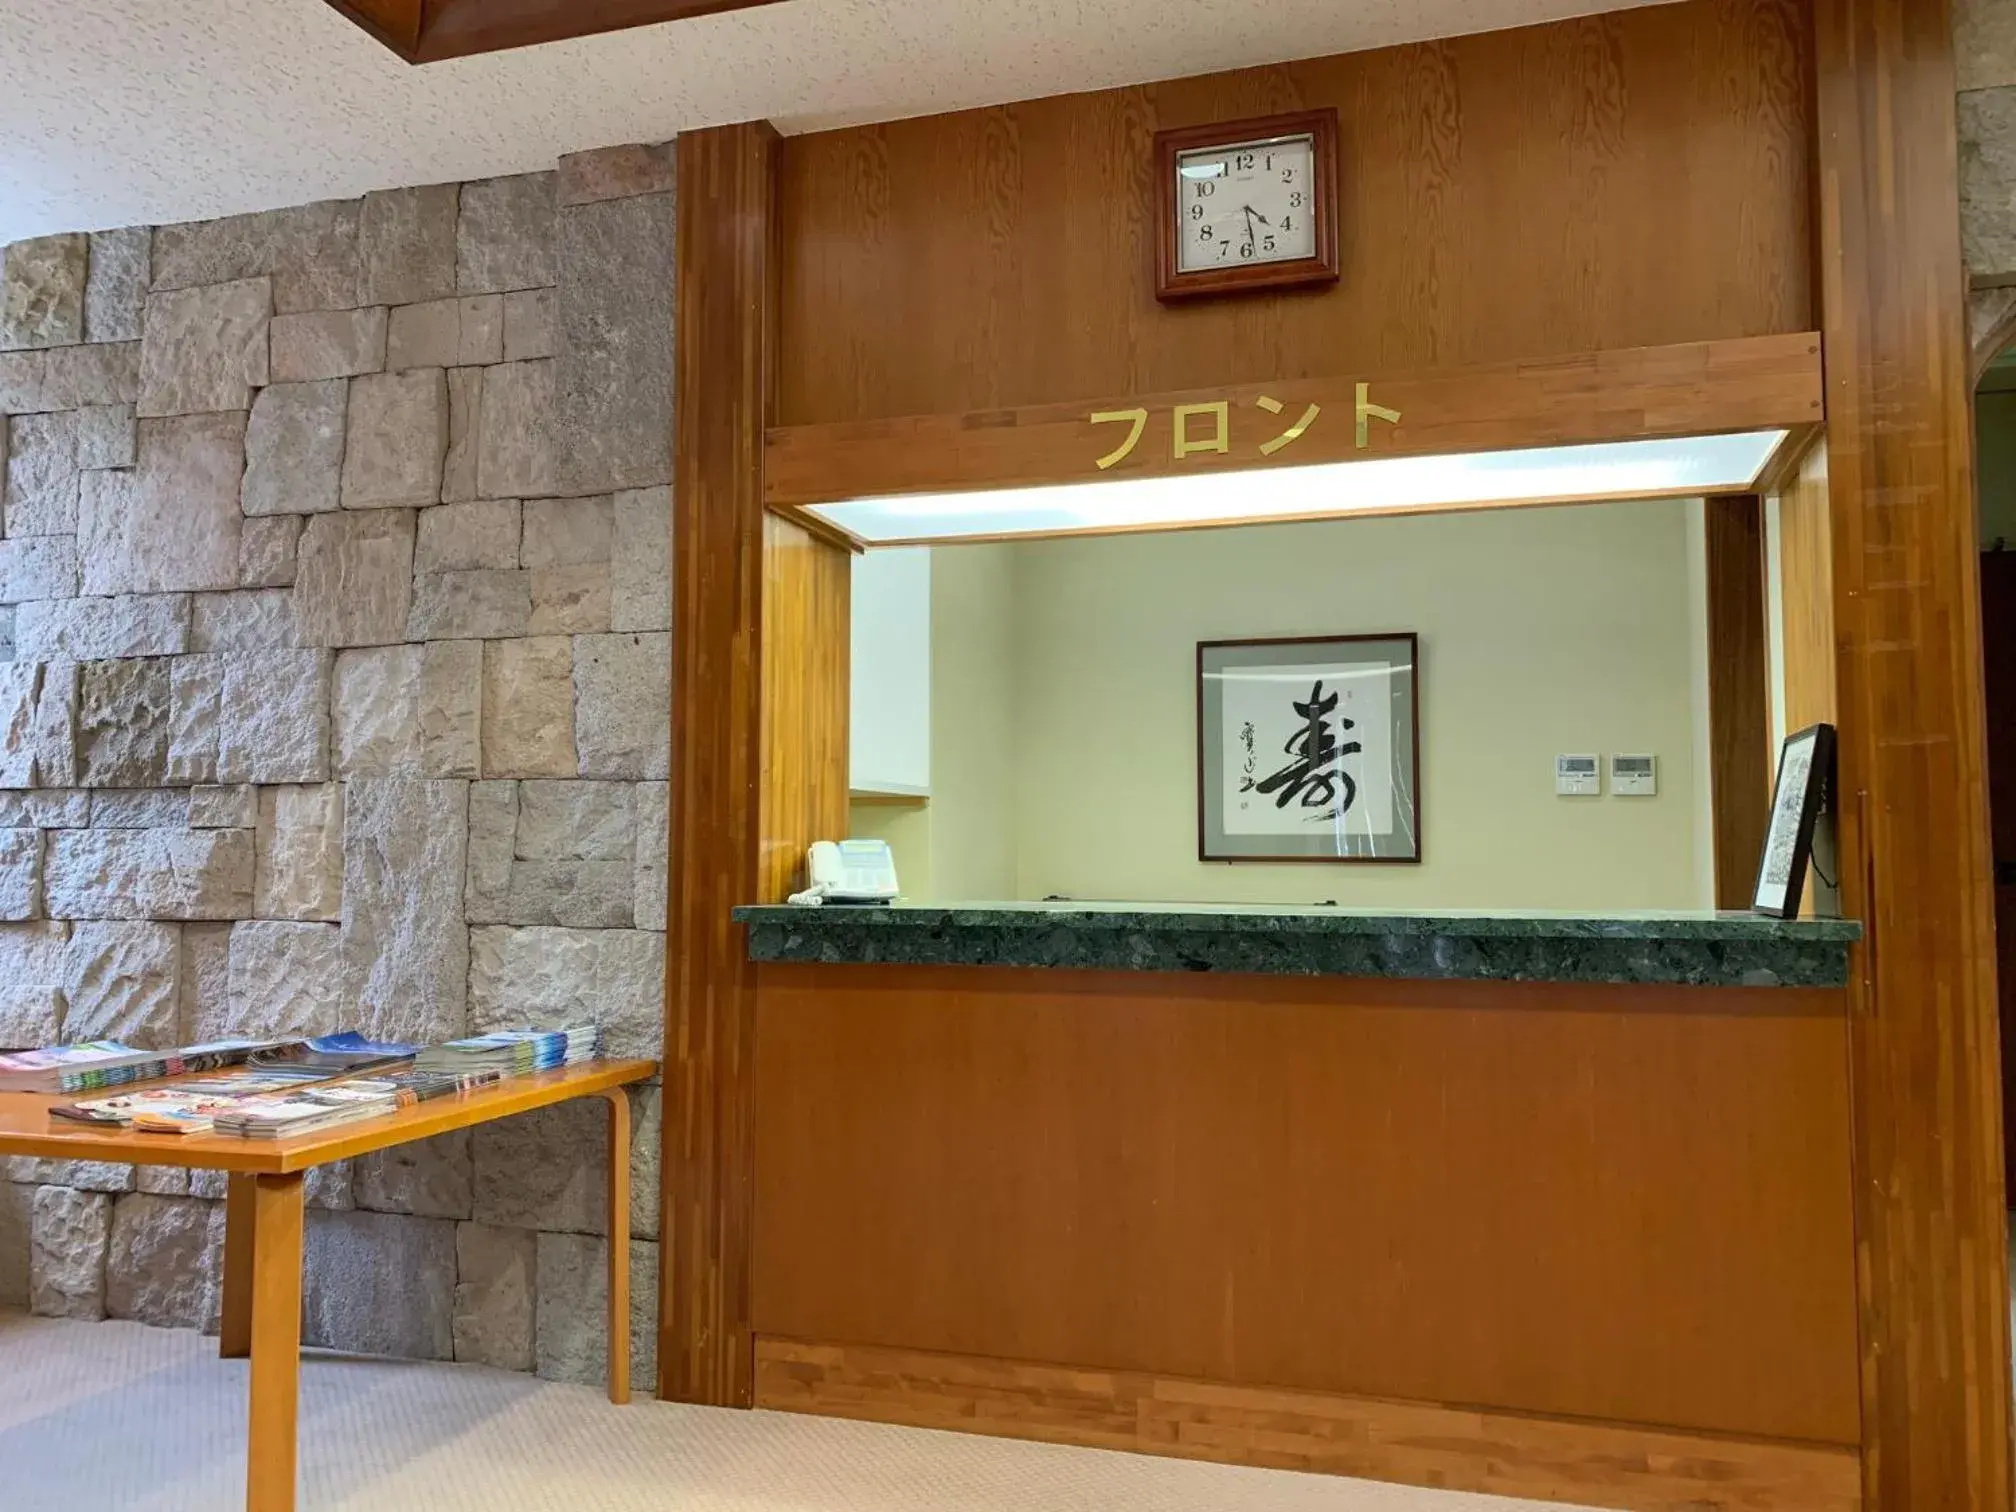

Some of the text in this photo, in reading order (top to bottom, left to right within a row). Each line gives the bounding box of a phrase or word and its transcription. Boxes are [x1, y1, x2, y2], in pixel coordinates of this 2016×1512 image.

[1236, 154, 1254, 171] 12
[1264, 155, 1272, 171] 1
[1281, 169, 1292, 184] 2
[1195, 181, 1215, 198] 10
[1289, 192, 1301, 208] 3
[1191, 204, 1204, 220] 9
[1280, 215, 1291, 232] 4
[1200, 225, 1213, 241] 8
[1219, 240, 1230, 256] 7
[1240, 242, 1253, 258] 6
[1263, 235, 1275, 251] 5
[1090, 382, 1402, 470] フロント
